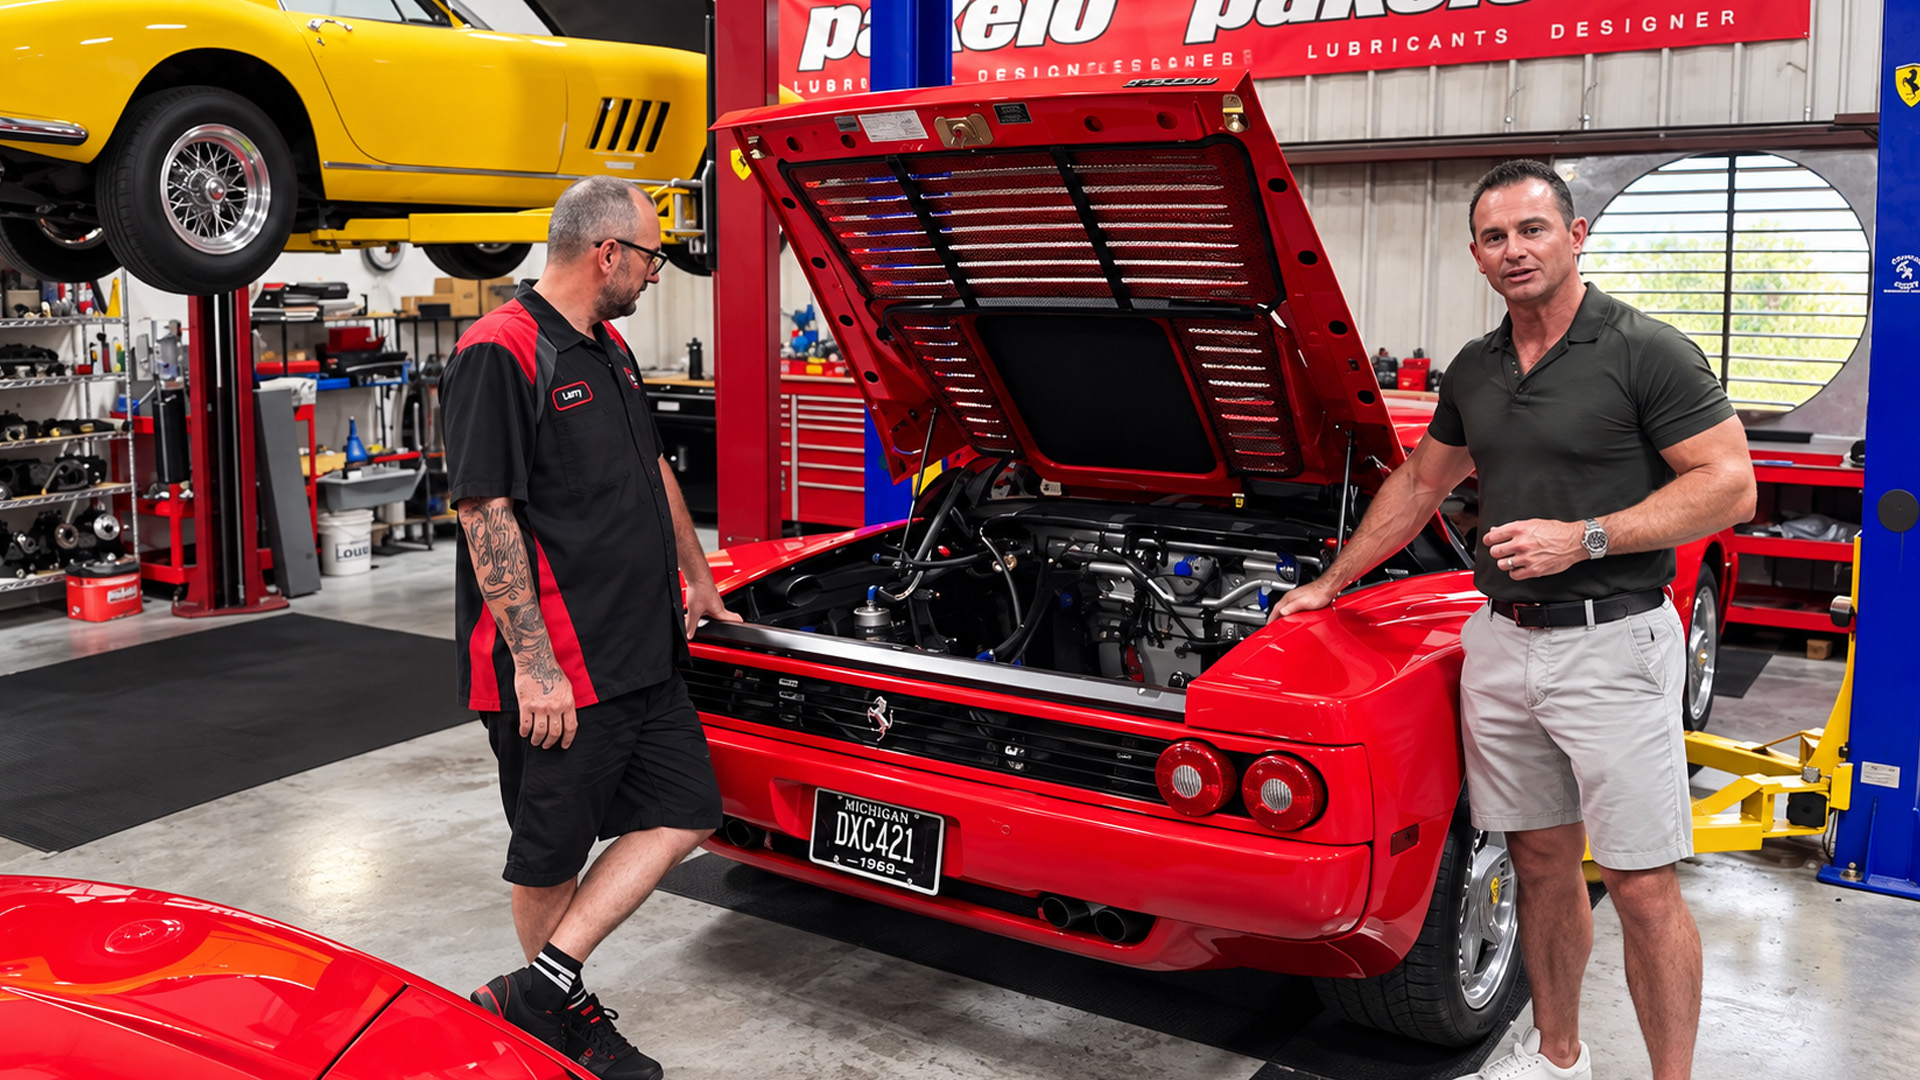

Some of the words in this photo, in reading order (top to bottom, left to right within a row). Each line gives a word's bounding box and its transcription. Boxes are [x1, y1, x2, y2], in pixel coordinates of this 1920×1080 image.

[1307, 28, 1508, 59] LUBRICANTS
[1550, 10, 1735, 39] DESIGNER
[845, 800, 909, 824] MICHIGAN
[835, 811, 914, 863] DXC421
